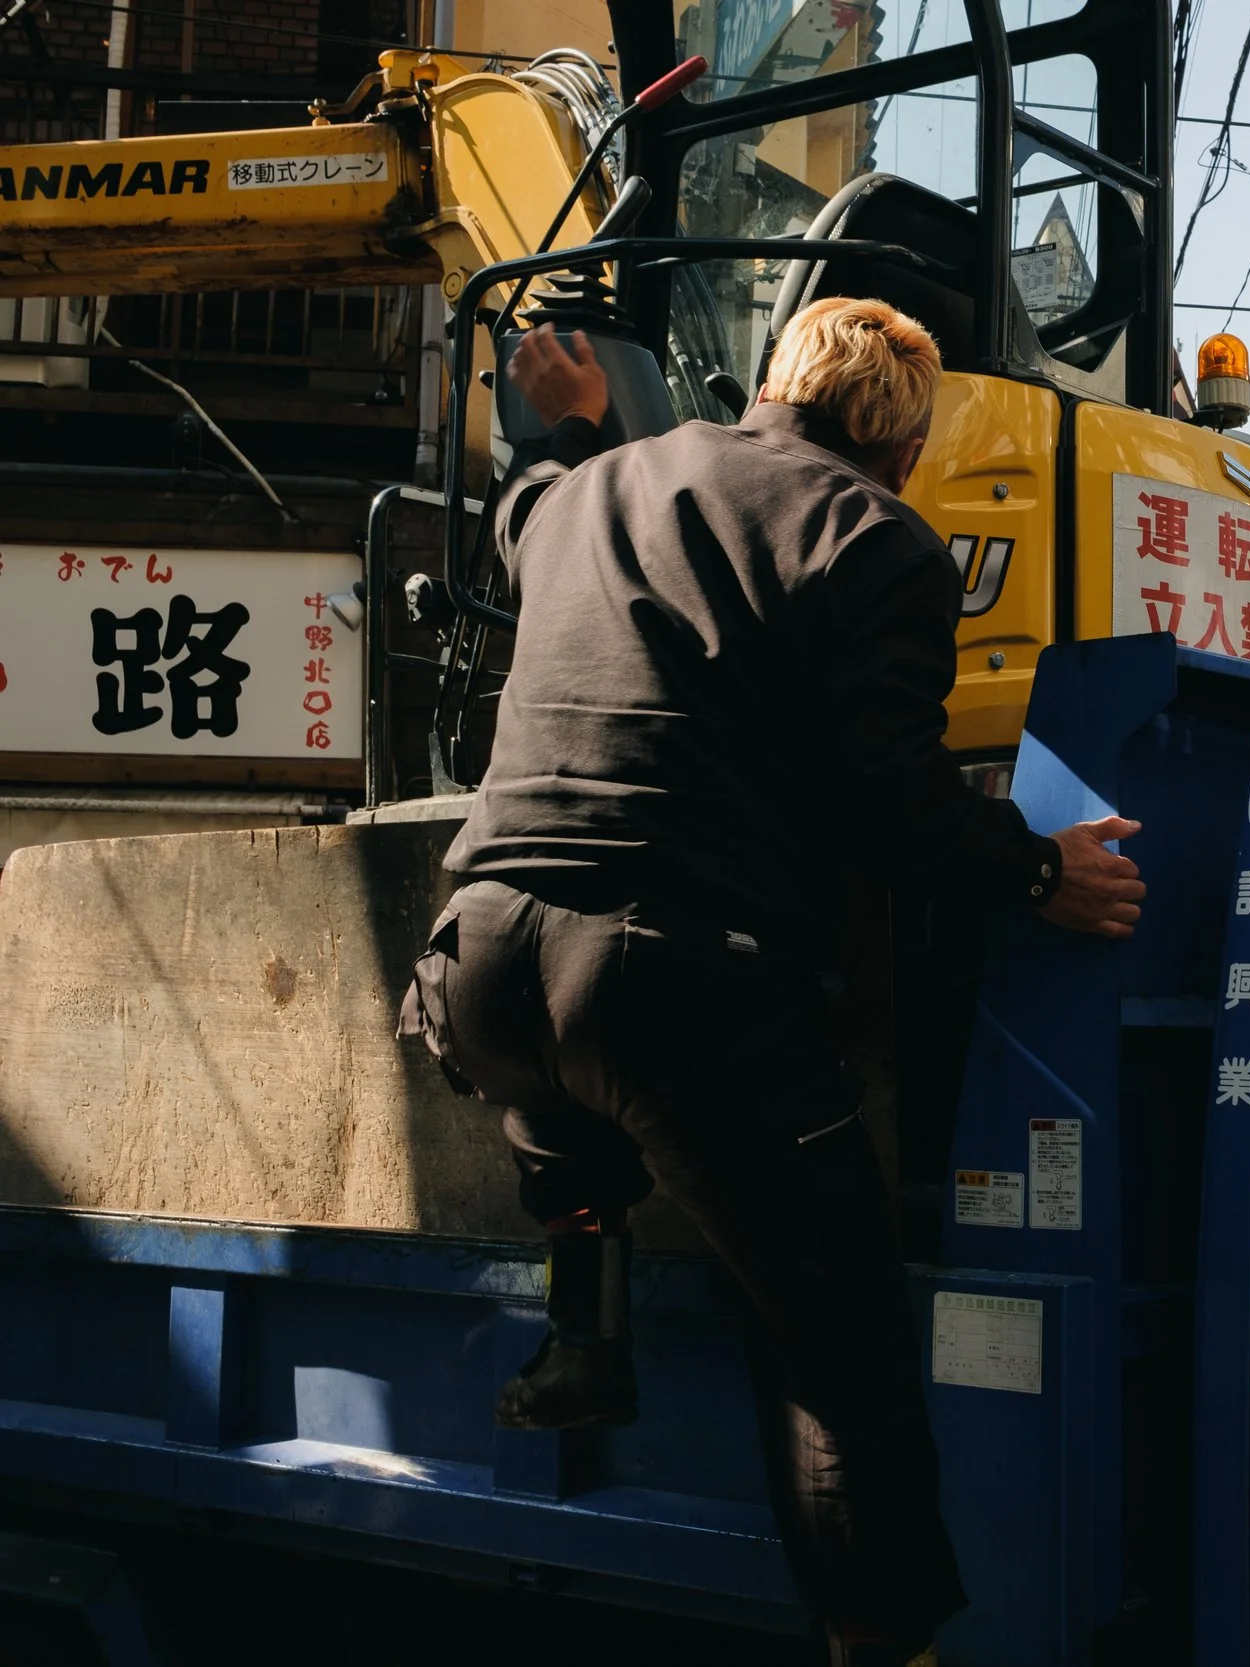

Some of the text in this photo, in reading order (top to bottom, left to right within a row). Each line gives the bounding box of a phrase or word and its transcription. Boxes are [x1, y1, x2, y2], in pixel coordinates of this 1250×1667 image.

[232, 160, 384, 186] 移動式クレーン
[57, 551, 173, 584] おでん
[90, 594, 251, 739] 路
[303, 592, 334, 749] 中野北口店
